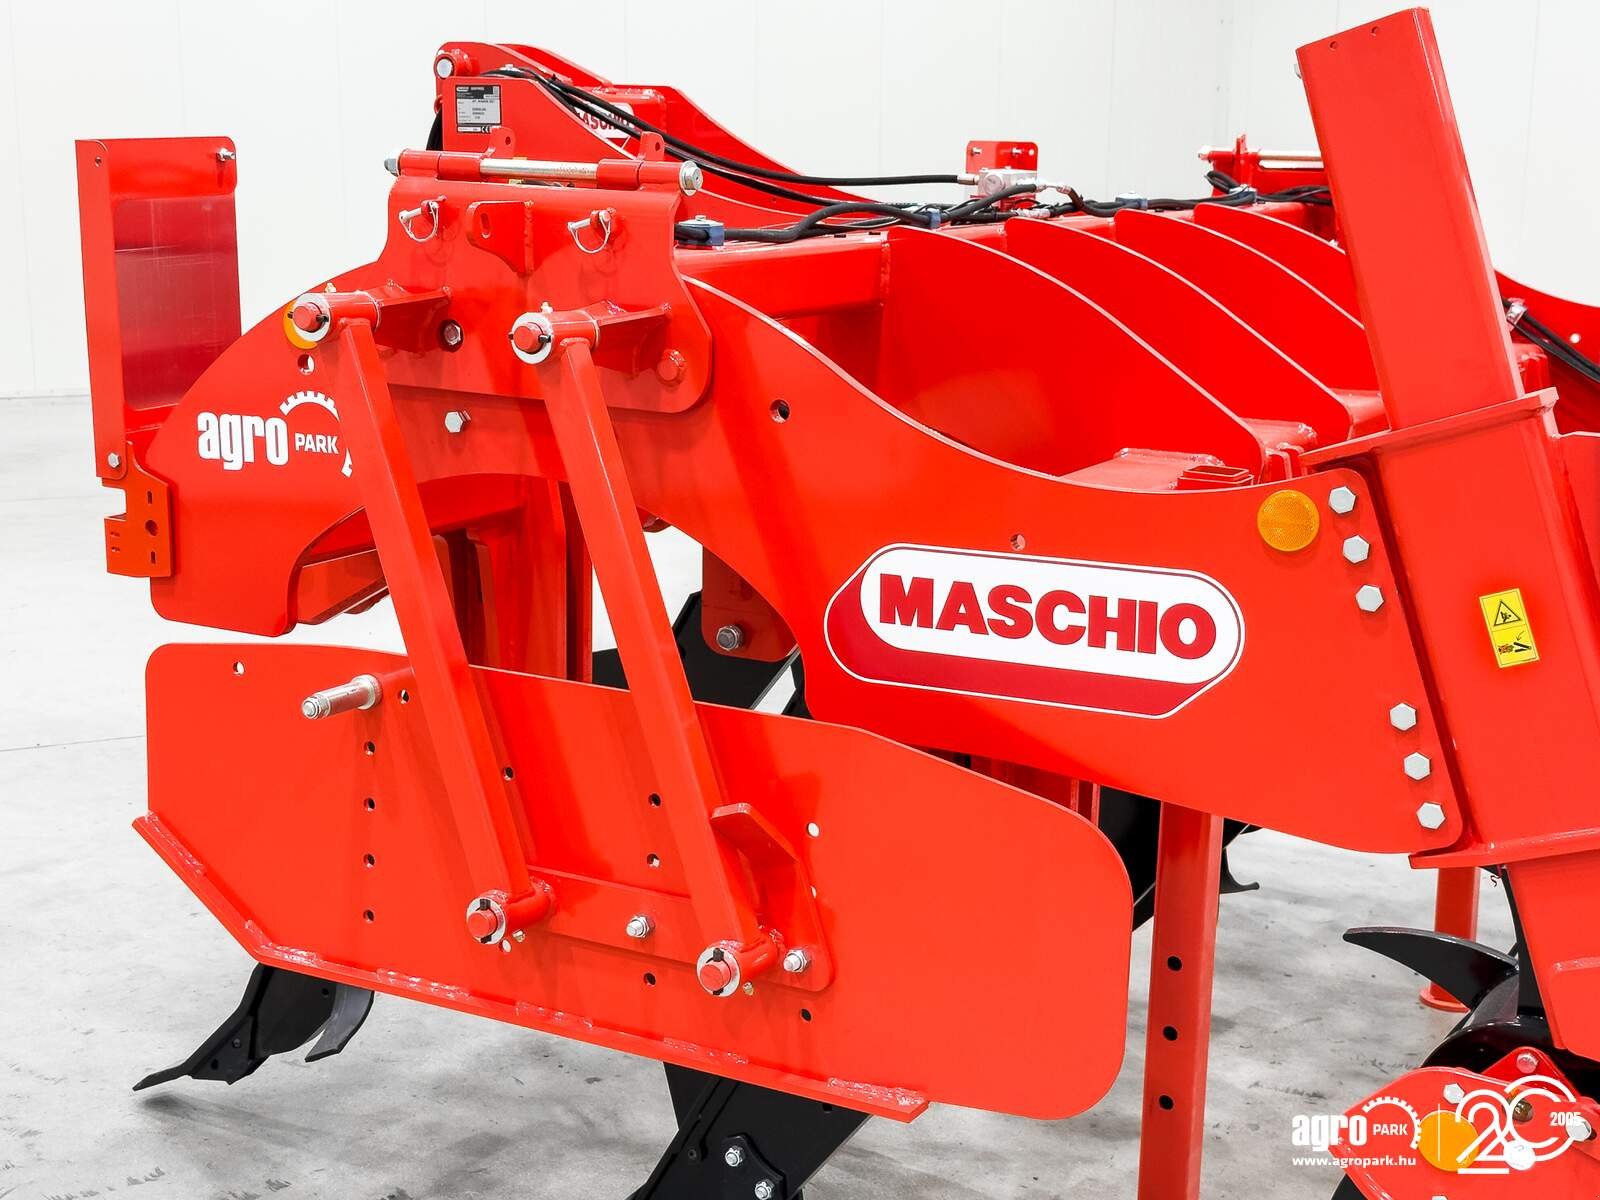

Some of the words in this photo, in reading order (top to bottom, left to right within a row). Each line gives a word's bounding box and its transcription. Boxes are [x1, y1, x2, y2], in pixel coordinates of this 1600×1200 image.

[197, 411, 289, 471] agro
[294, 432, 339, 454] PARK
[879, 573, 1217, 660] MASCHIO
